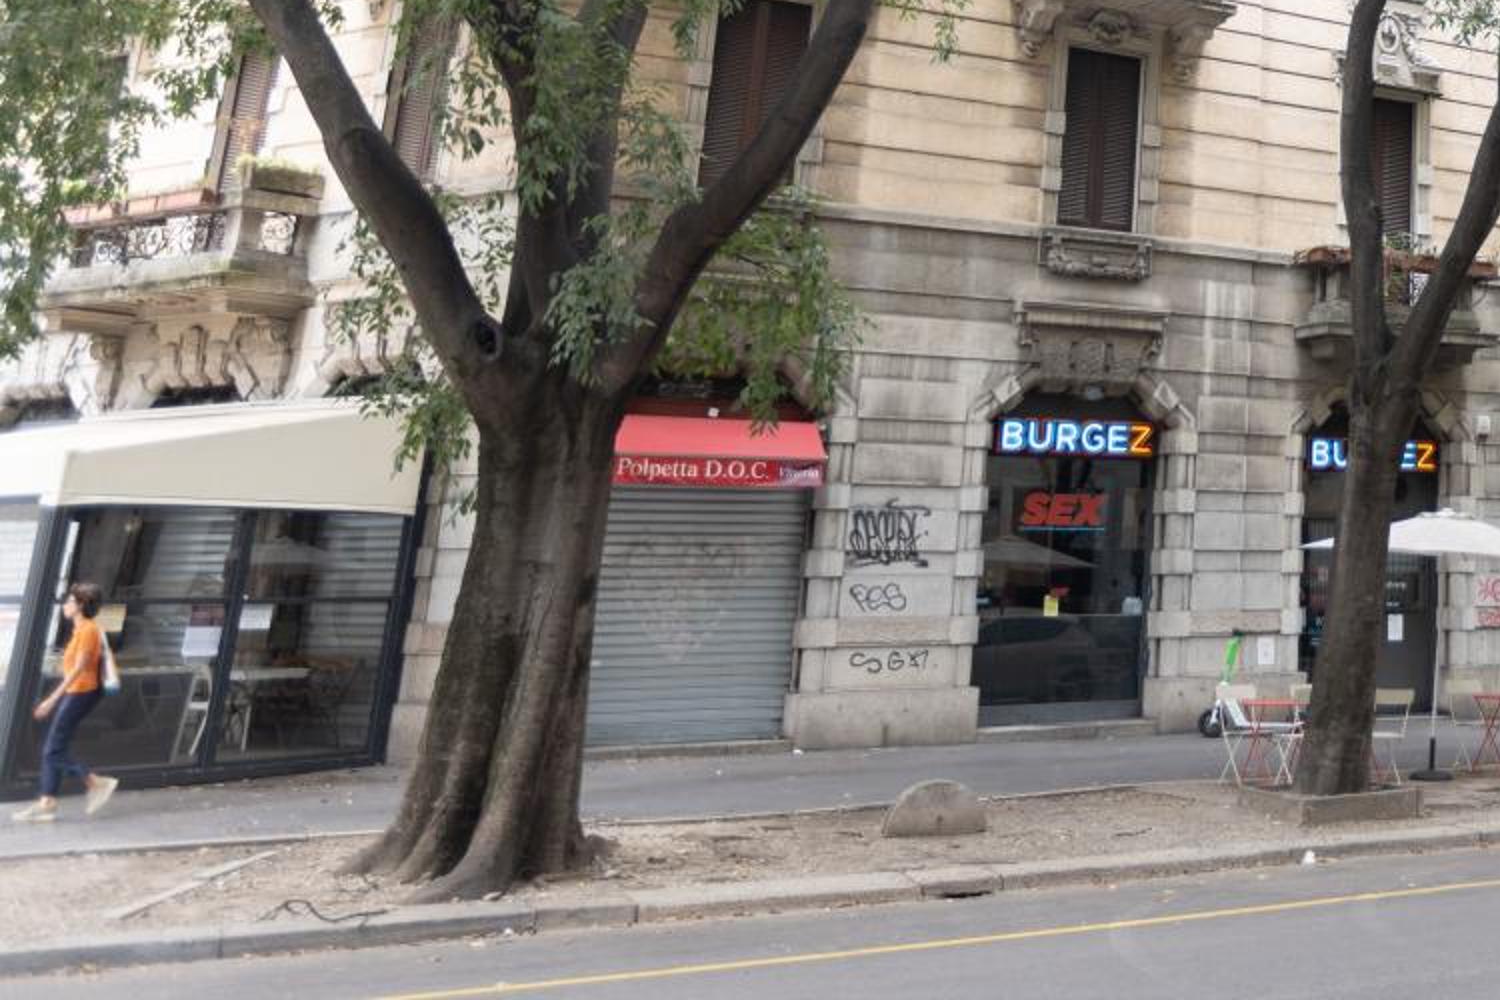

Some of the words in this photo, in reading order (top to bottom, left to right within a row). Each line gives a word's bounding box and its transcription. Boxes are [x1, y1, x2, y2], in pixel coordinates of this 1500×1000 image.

[1001, 420, 1152, 453] BURGEZ
[616, 456, 699, 481] Polpetta
[704, 460, 769, 479] D.O.C.
[1310, 438, 1437, 471] BUEZ
[1021, 490, 1105, 527] SEX
